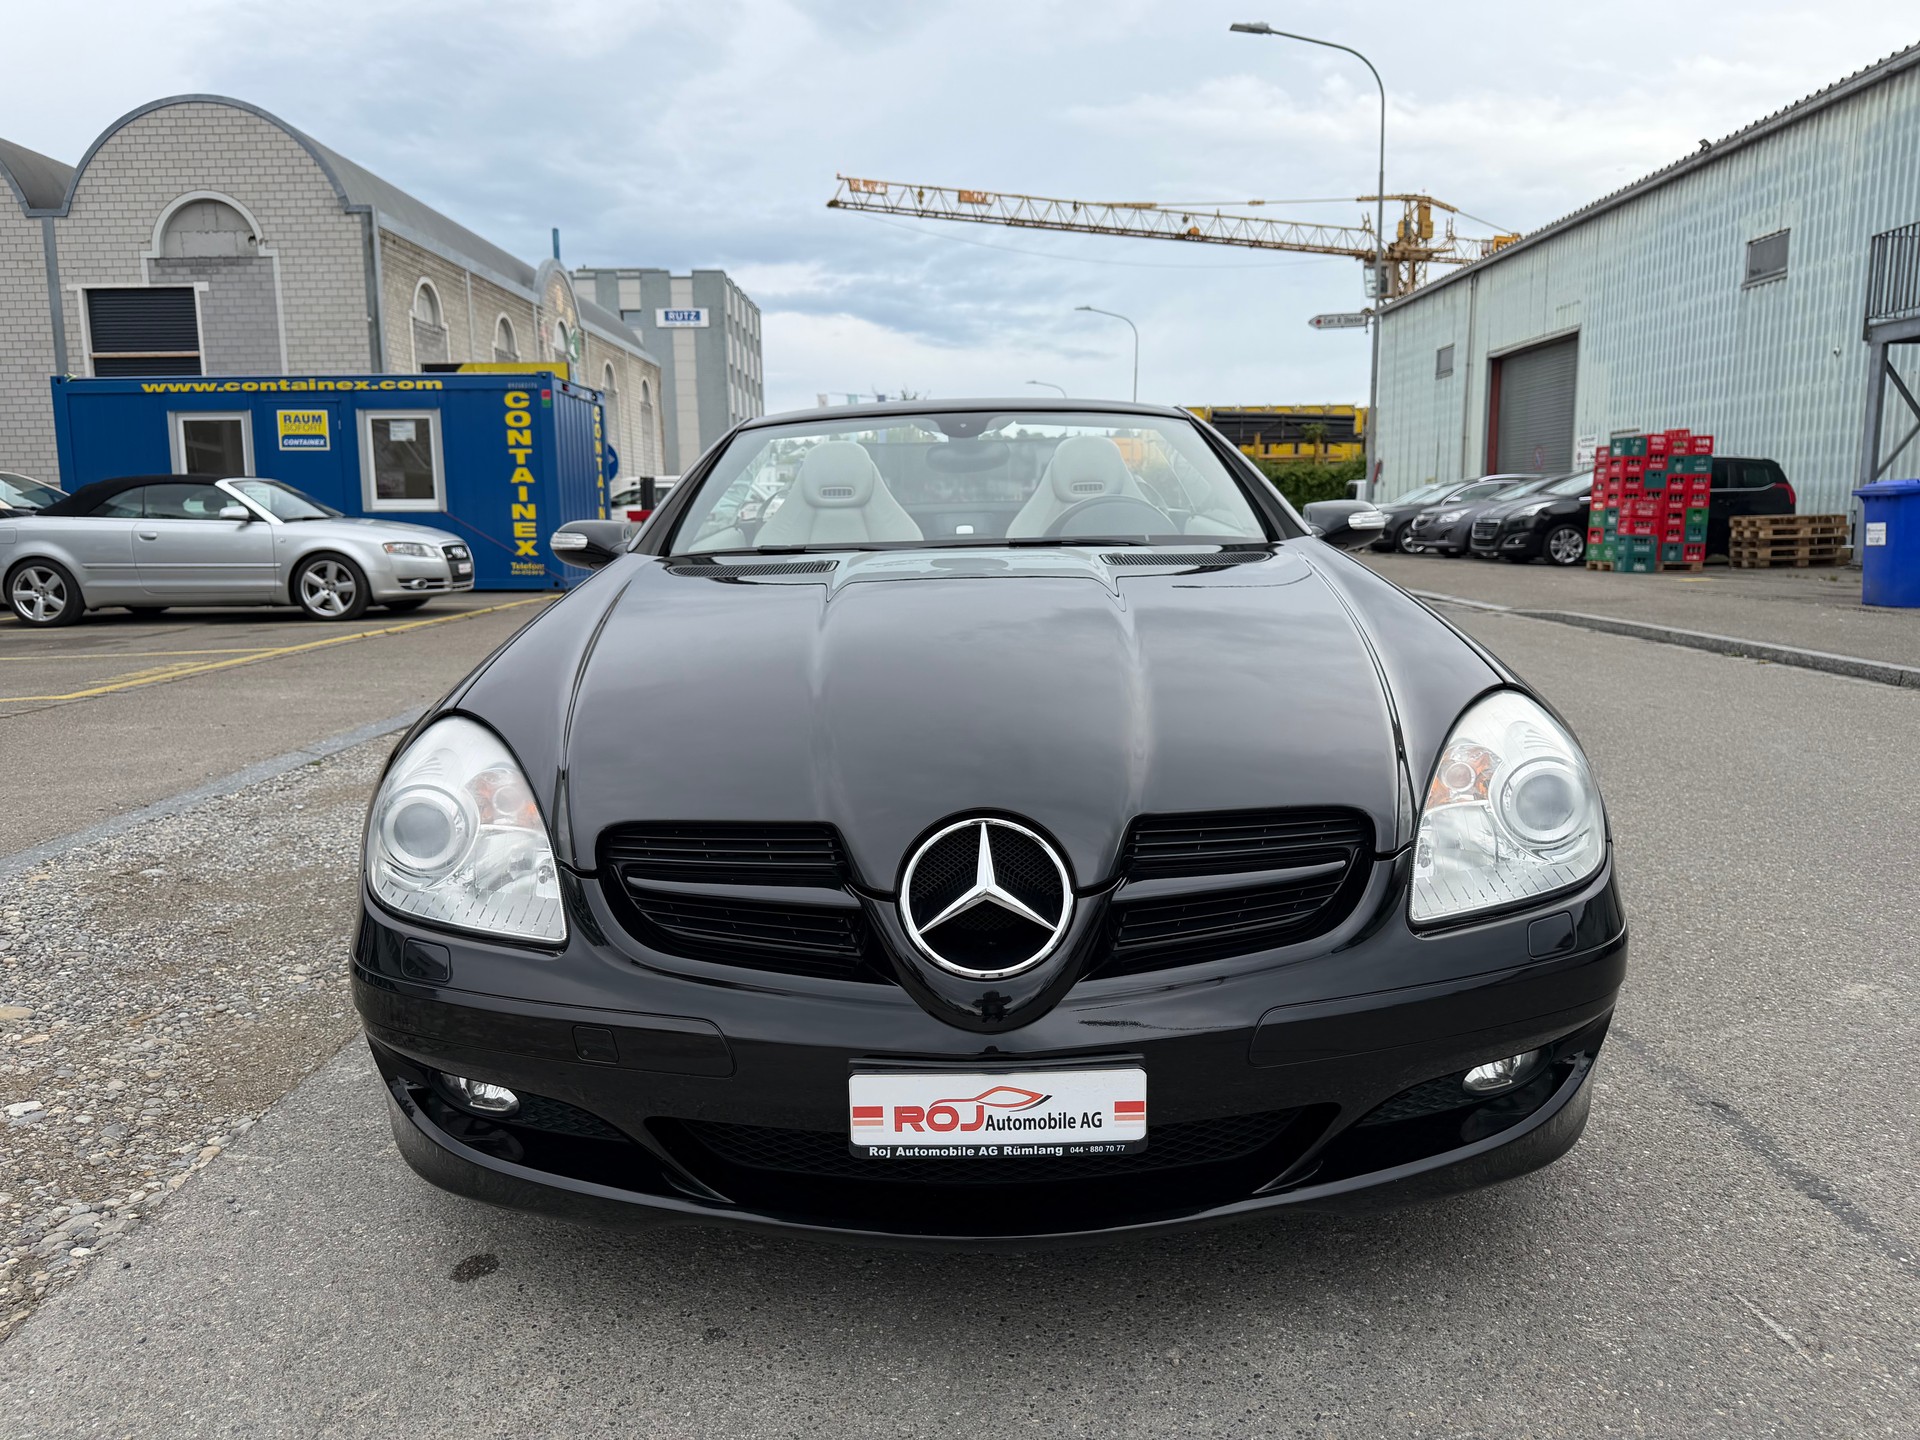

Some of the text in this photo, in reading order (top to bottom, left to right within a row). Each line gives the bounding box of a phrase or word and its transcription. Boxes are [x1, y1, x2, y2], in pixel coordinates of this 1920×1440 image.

[667, 311, 697, 321] RUTZ
[141, 378, 444, 393] www.containex.com
[283, 414, 322, 424] RAUM
[283, 438, 325, 447] CONTAINEX
[593, 405, 606, 520] CONTAIN
[504, 391, 539, 556] CONTAINEX
[894, 1104, 984, 1132] ROJ
[985, 1112, 1103, 1132] Automobile AG
[869, 1146, 891, 1158] Roj
[896, 1146, 975, 1156] Automobile
[979, 1146, 998, 1156] AG
[1003, 1145, 1063, 1157] Rümlang
[1070, 1146, 1084, 1154] 044
[1090, 1145, 1104, 1153] 880
[1105, 1144, 1115, 1152] 70
[1117, 1144, 1126, 1152] 77
